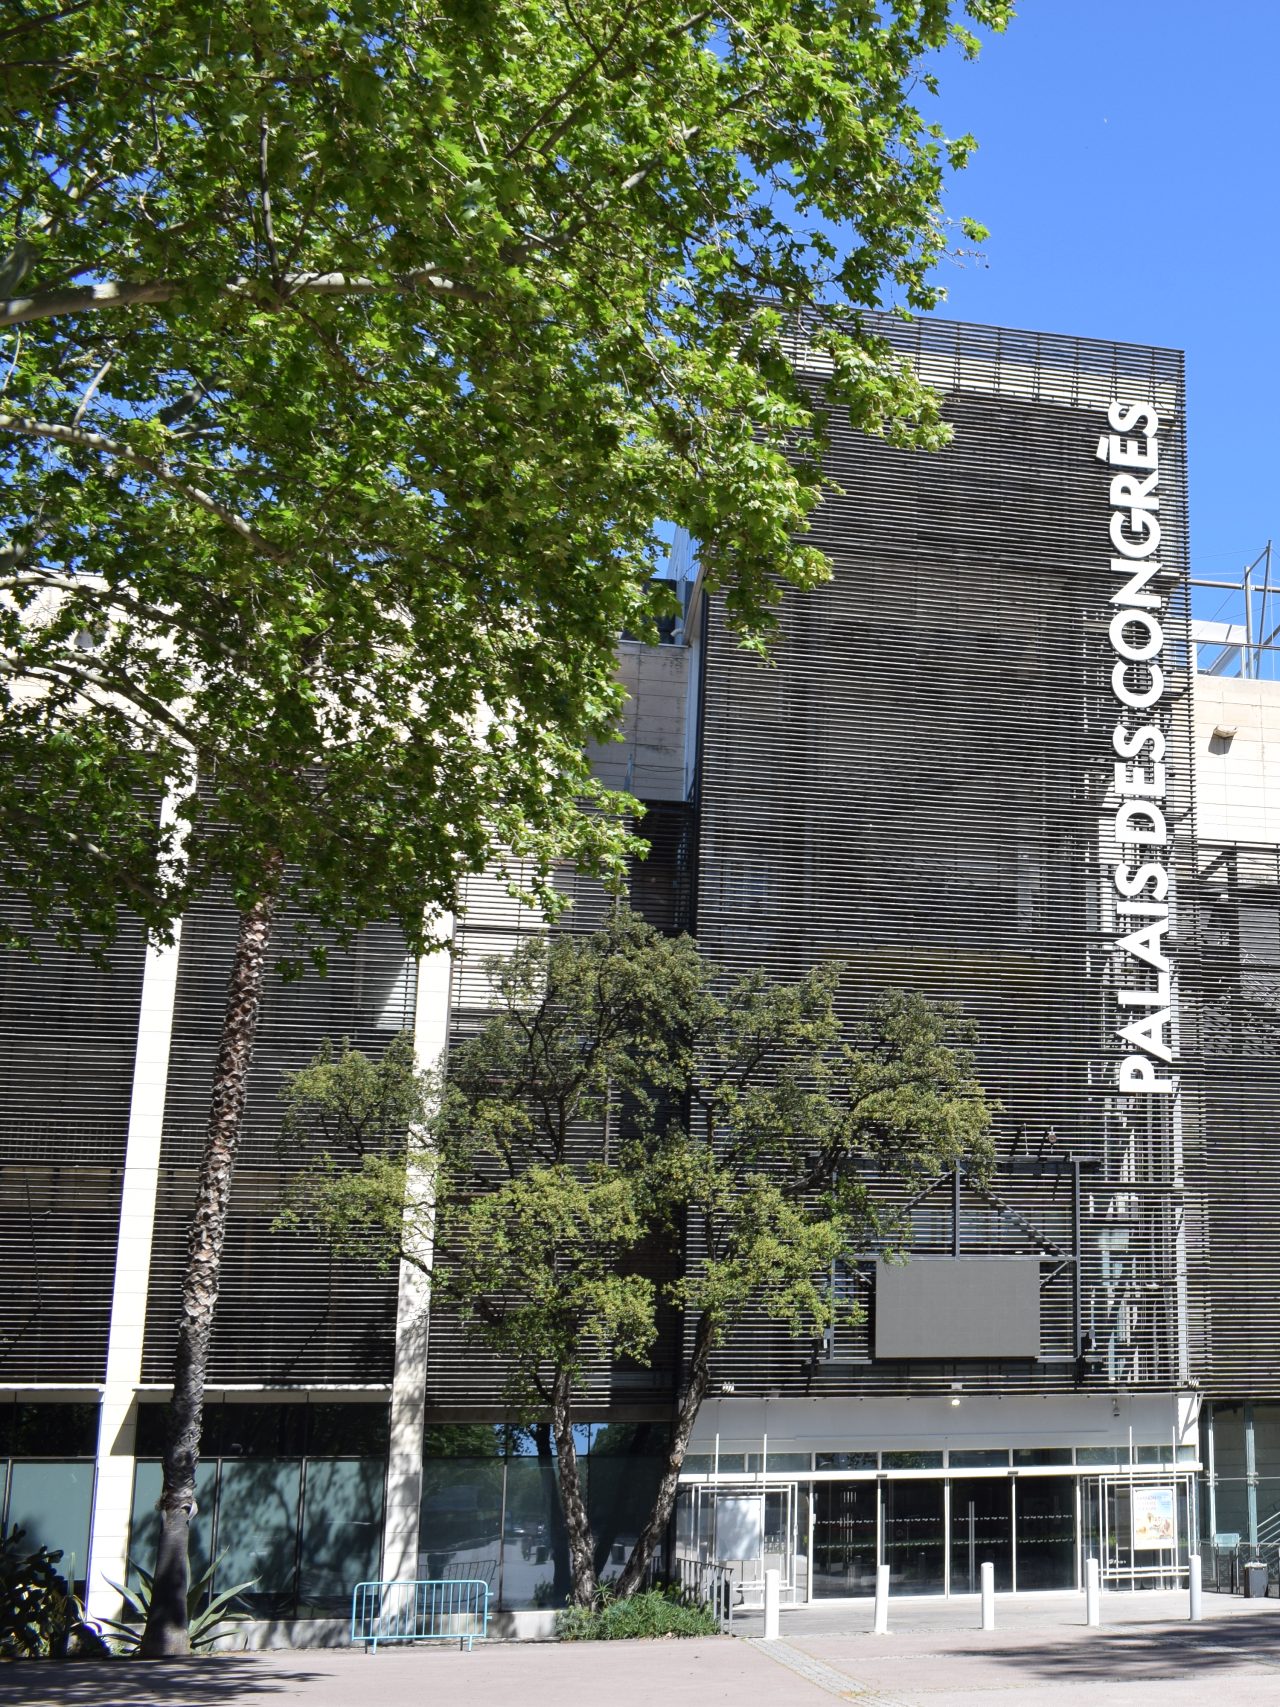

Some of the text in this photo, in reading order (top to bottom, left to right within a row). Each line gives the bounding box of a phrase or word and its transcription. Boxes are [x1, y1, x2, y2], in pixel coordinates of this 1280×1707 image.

[1096, 401, 1172, 1093] PALAIS DES CONGRÈS
